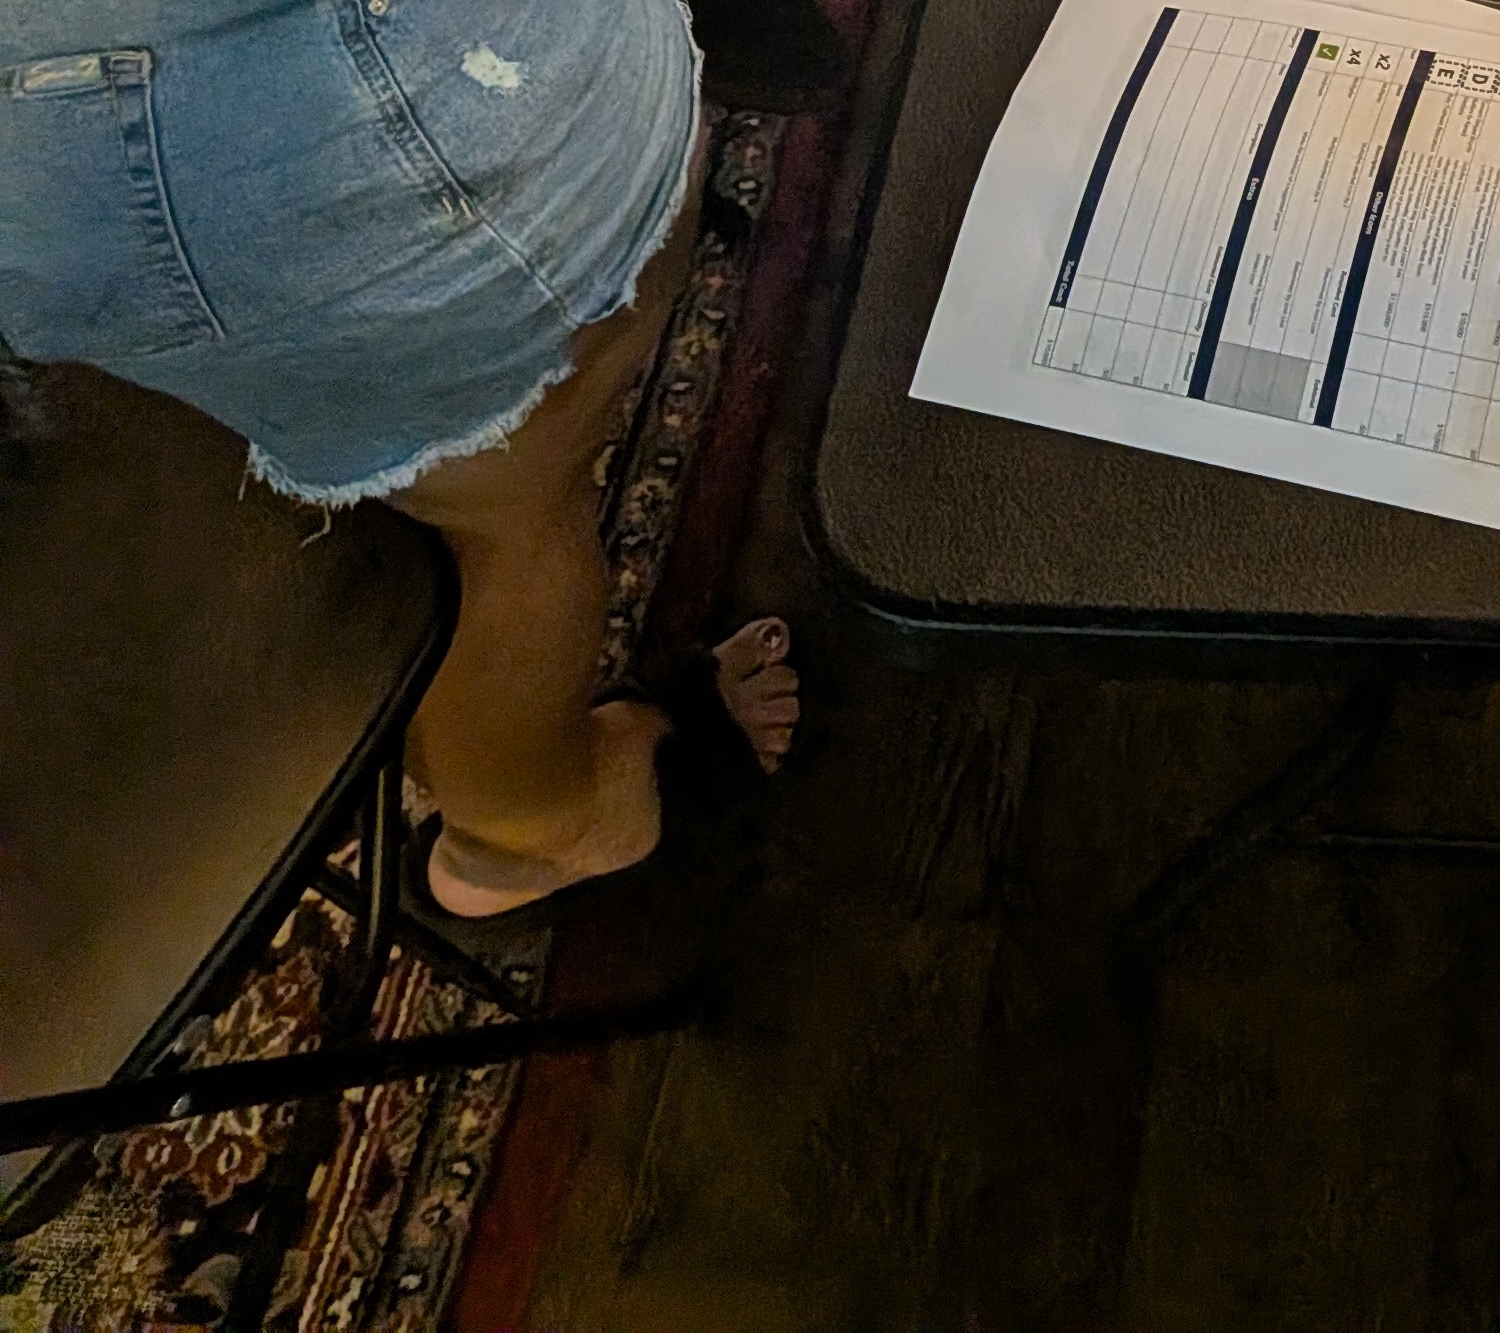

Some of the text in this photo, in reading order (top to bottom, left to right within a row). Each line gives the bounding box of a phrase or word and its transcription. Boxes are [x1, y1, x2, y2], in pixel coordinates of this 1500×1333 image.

[1347, 49, 1361, 65] x4
[1375, 54, 1390, 70] x2
[1437, 68, 1455, 79] E
[1472, 74, 1489, 84] D
[1246, 178, 1259, 200] Extras
[1373, 192, 1383, 210] Other
